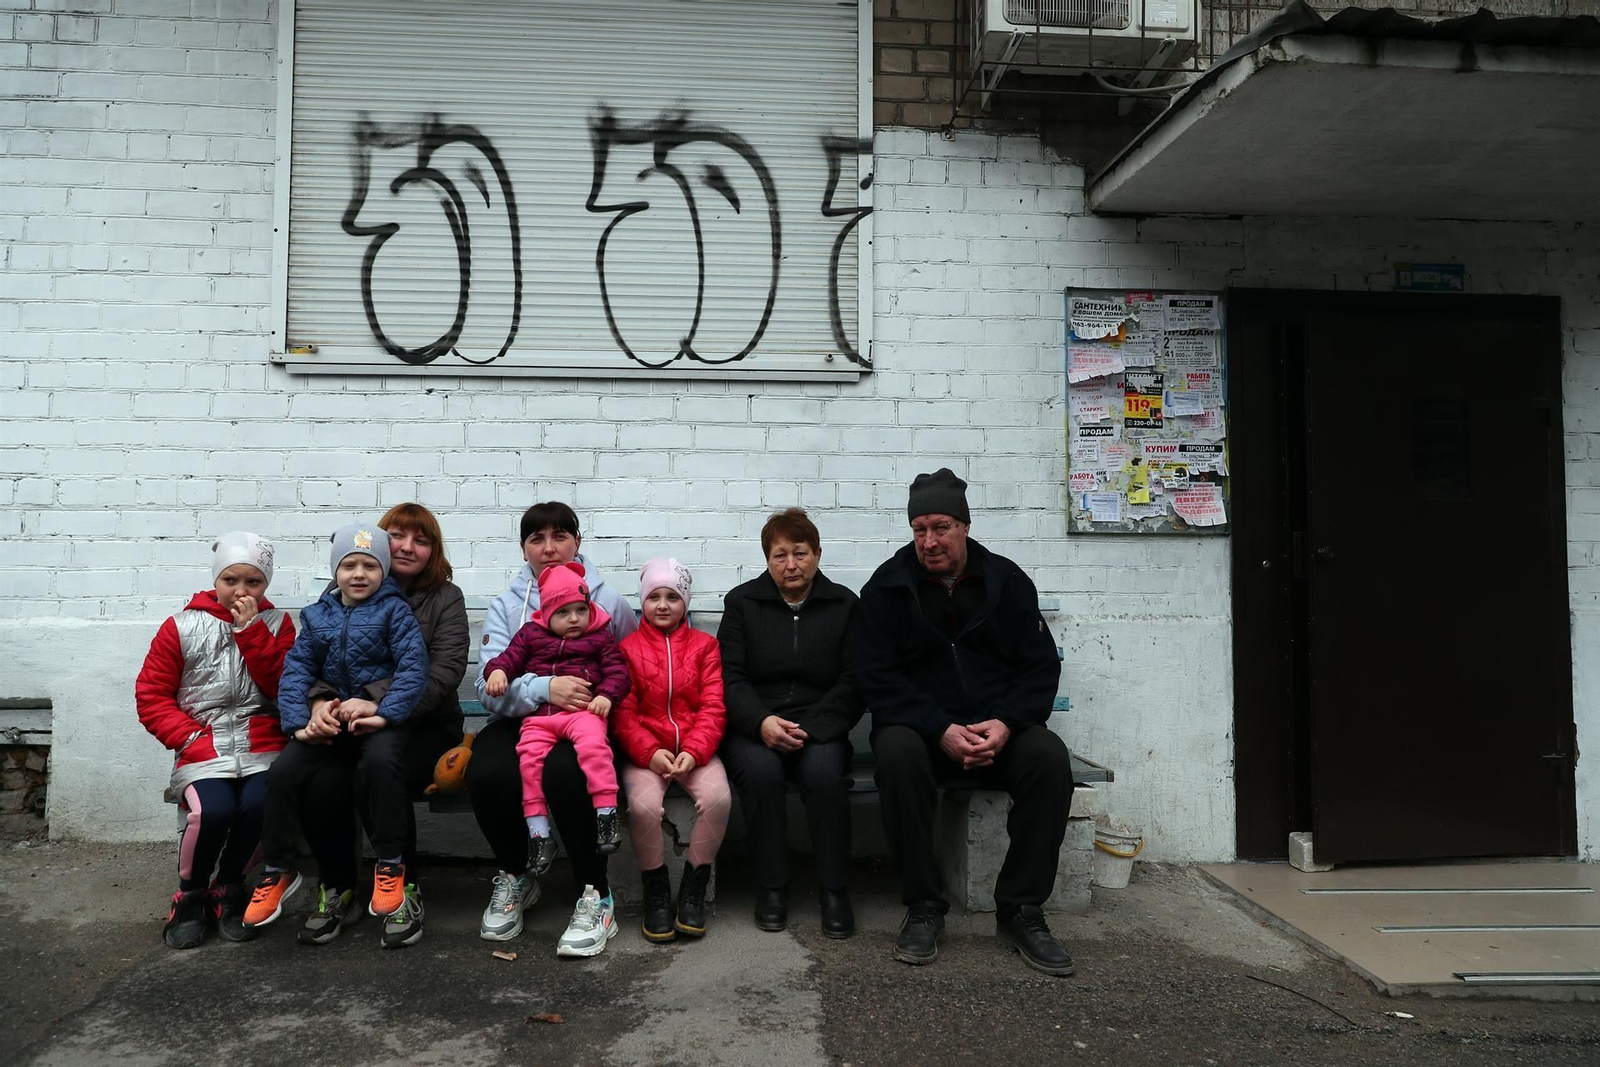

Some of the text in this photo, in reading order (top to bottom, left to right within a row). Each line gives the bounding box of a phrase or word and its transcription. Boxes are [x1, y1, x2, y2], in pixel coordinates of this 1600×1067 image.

[1074, 302, 1123, 311] САНТЕХНИК
[1127, 399, 1150, 413] 119
[1079, 428, 1114, 436] ПРОДАМ
[1145, 445, 1177, 453] КУПИМ
[1069, 472, 1095, 480] РАБОТА
